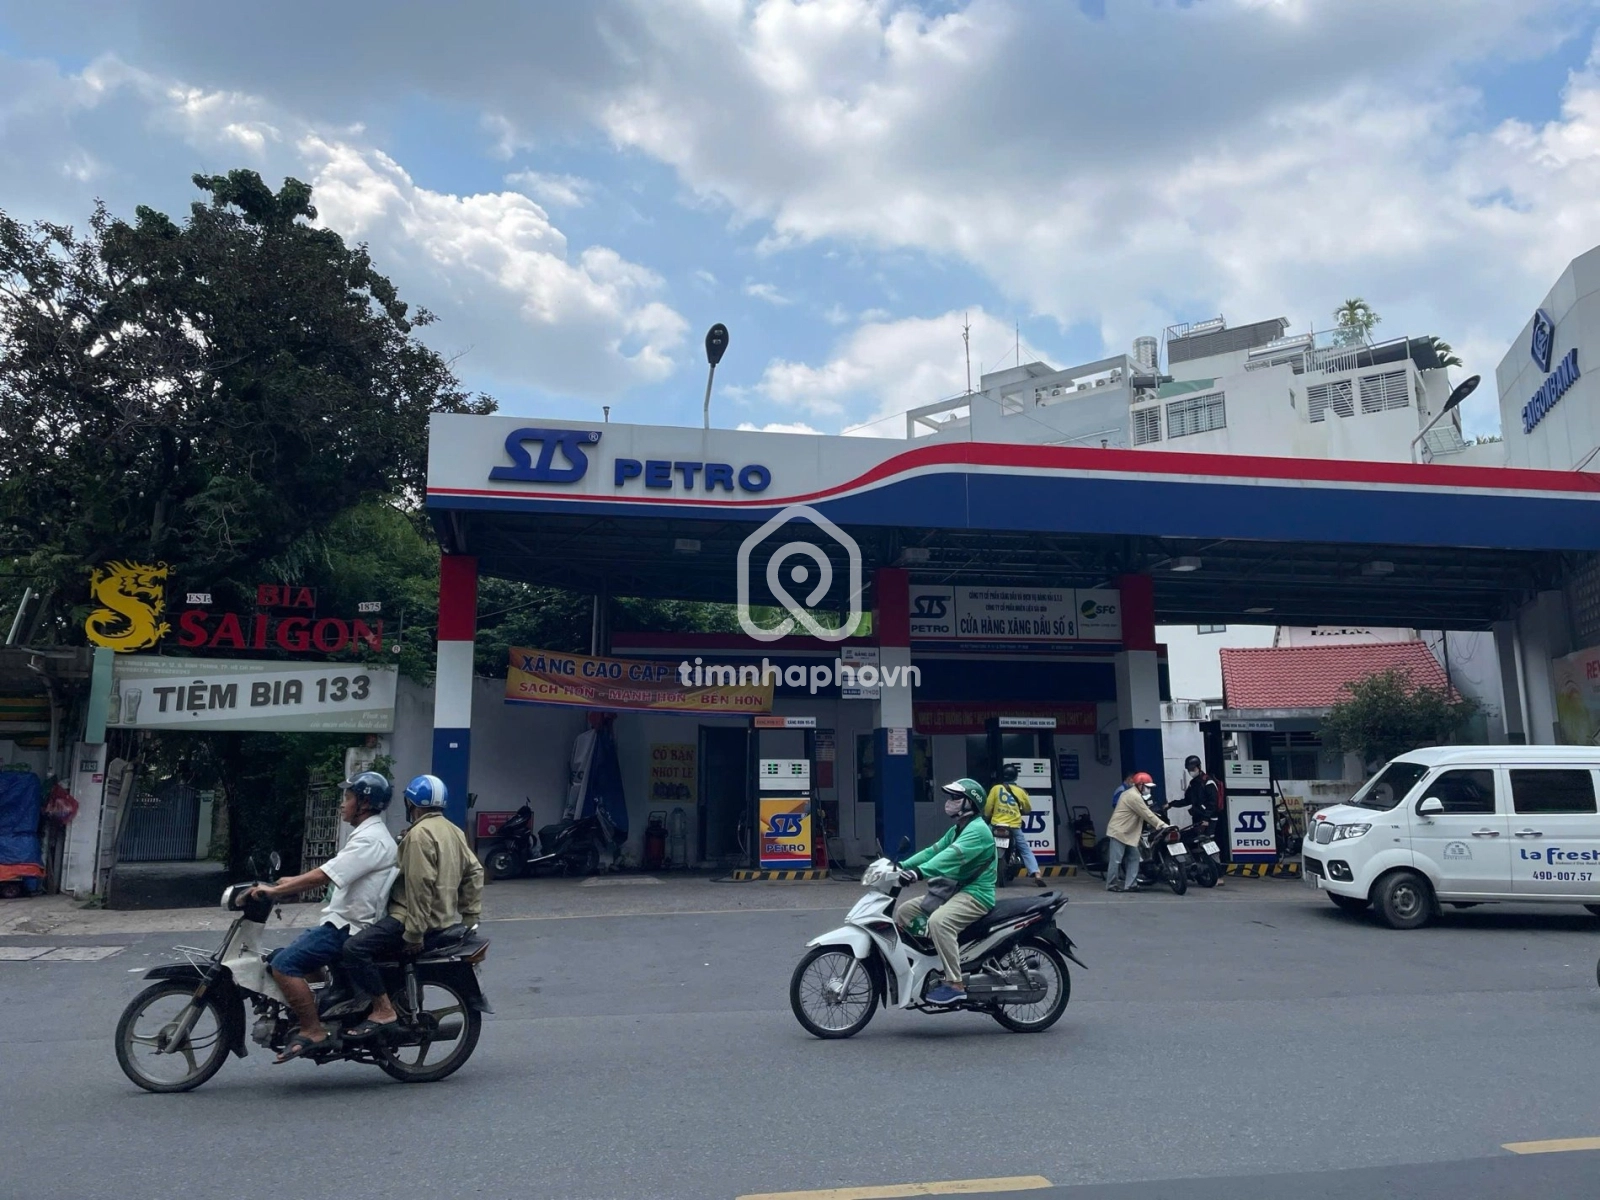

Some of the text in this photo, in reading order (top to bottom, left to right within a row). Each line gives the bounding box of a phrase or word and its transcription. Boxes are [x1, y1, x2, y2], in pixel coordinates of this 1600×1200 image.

[1522, 348, 1580, 434] SAIGONBANK
[489, 427, 602, 483] STS
[614, 458, 772, 493] PETRO
[256, 584, 315, 608] BIA
[359, 602, 381, 612] 1875
[910, 595, 952, 619] STS
[1096, 605, 1116, 615] SFC
[177, 609, 385, 653] SAIGON
[911, 624, 950, 634] PETRO
[960, 613, 1074, 636] CỬA HÀNG XĂNG DẦU SỐ 8
[522, 654, 576, 677] XĂNG
[582, 660, 622, 680] CAO
[629, 660, 669, 682] CẤP
[153, 675, 371, 717] TIỆM BIA 133
[519, 682, 763, 706] SẠCH HƠN MẠNH HƠN BỀN HƠN
[971, 789, 983, 804] Grab
[998, 787, 1017, 806] be
[764, 813, 807, 838] STS
[1234, 811, 1271, 833] STS
[766, 844, 806, 853] PETRO
[1028, 840, 1050, 848] TRO
[1237, 839, 1271, 847] PETRO
[1533, 871, 1593, 881] 49D-007.57
